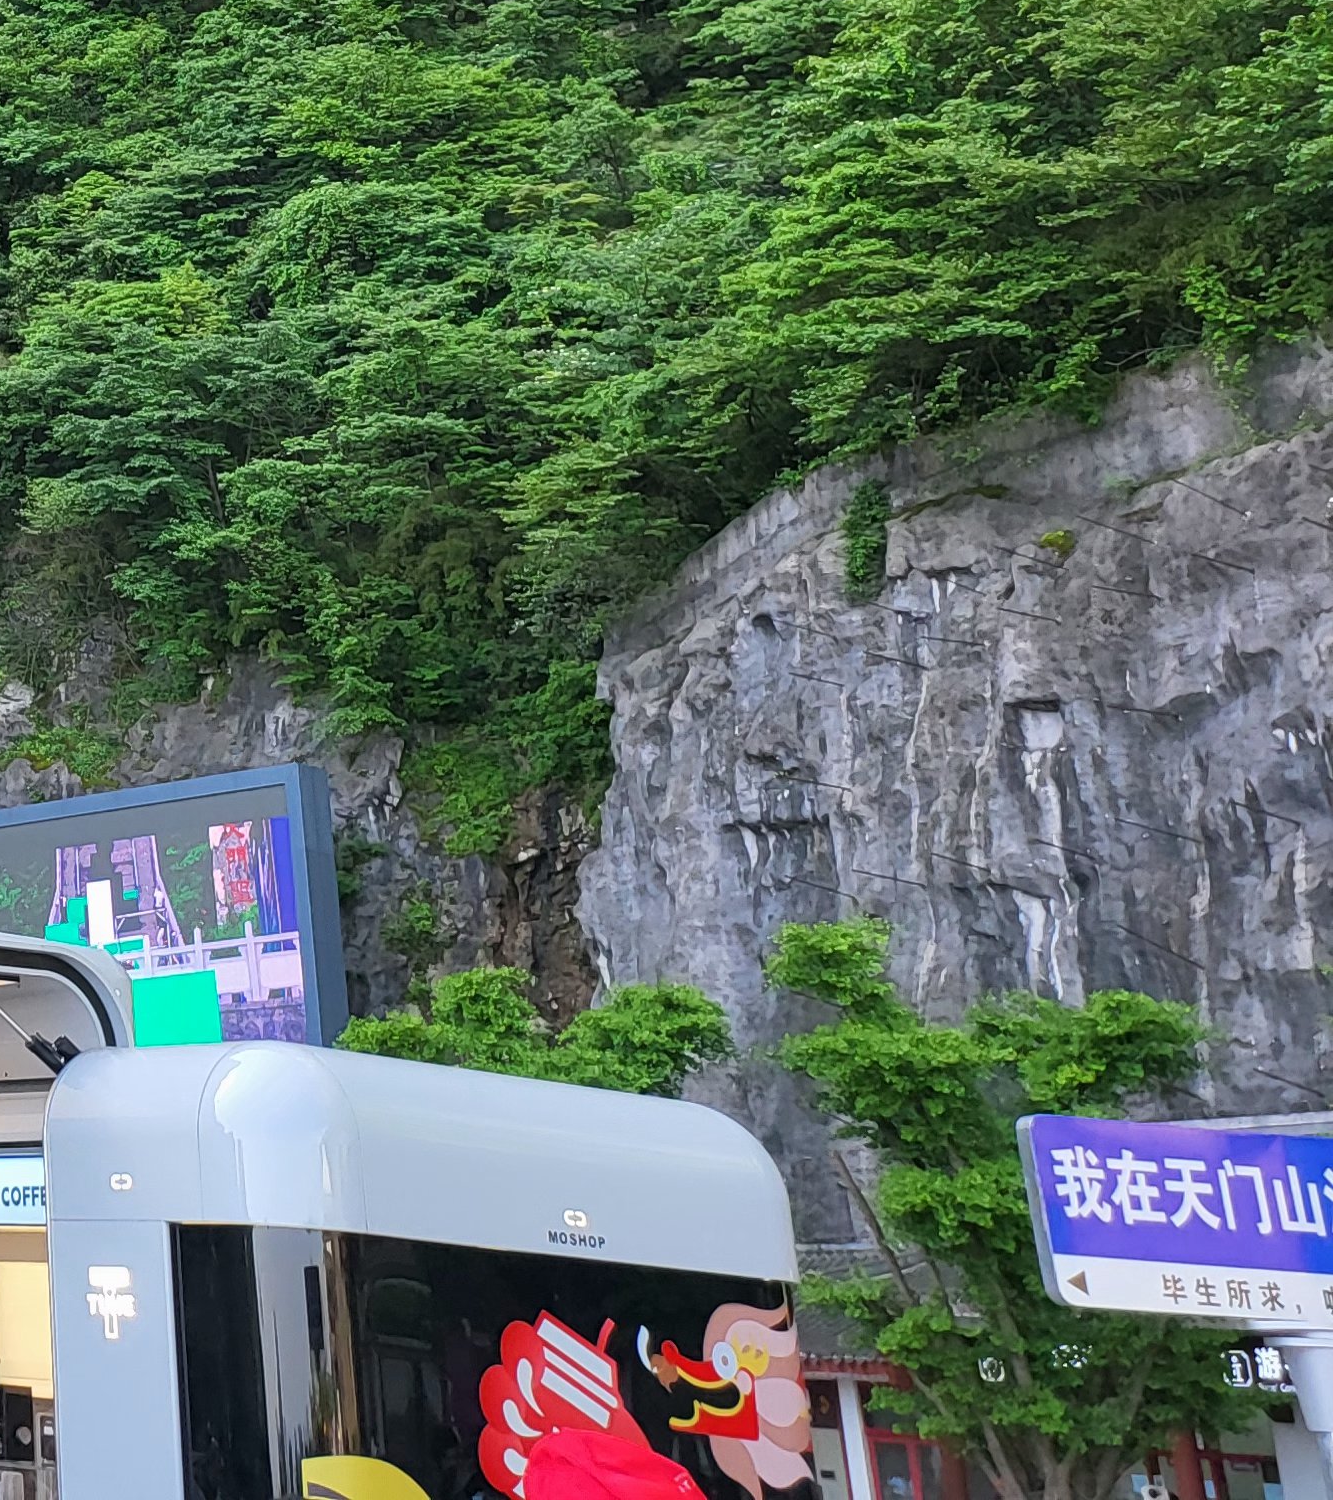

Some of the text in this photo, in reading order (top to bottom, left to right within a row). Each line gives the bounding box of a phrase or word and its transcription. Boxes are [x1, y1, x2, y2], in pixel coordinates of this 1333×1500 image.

[1050, 1145, 1333, 1237] 我在天门山
[548, 1230, 606, 1249] MOSHOP
